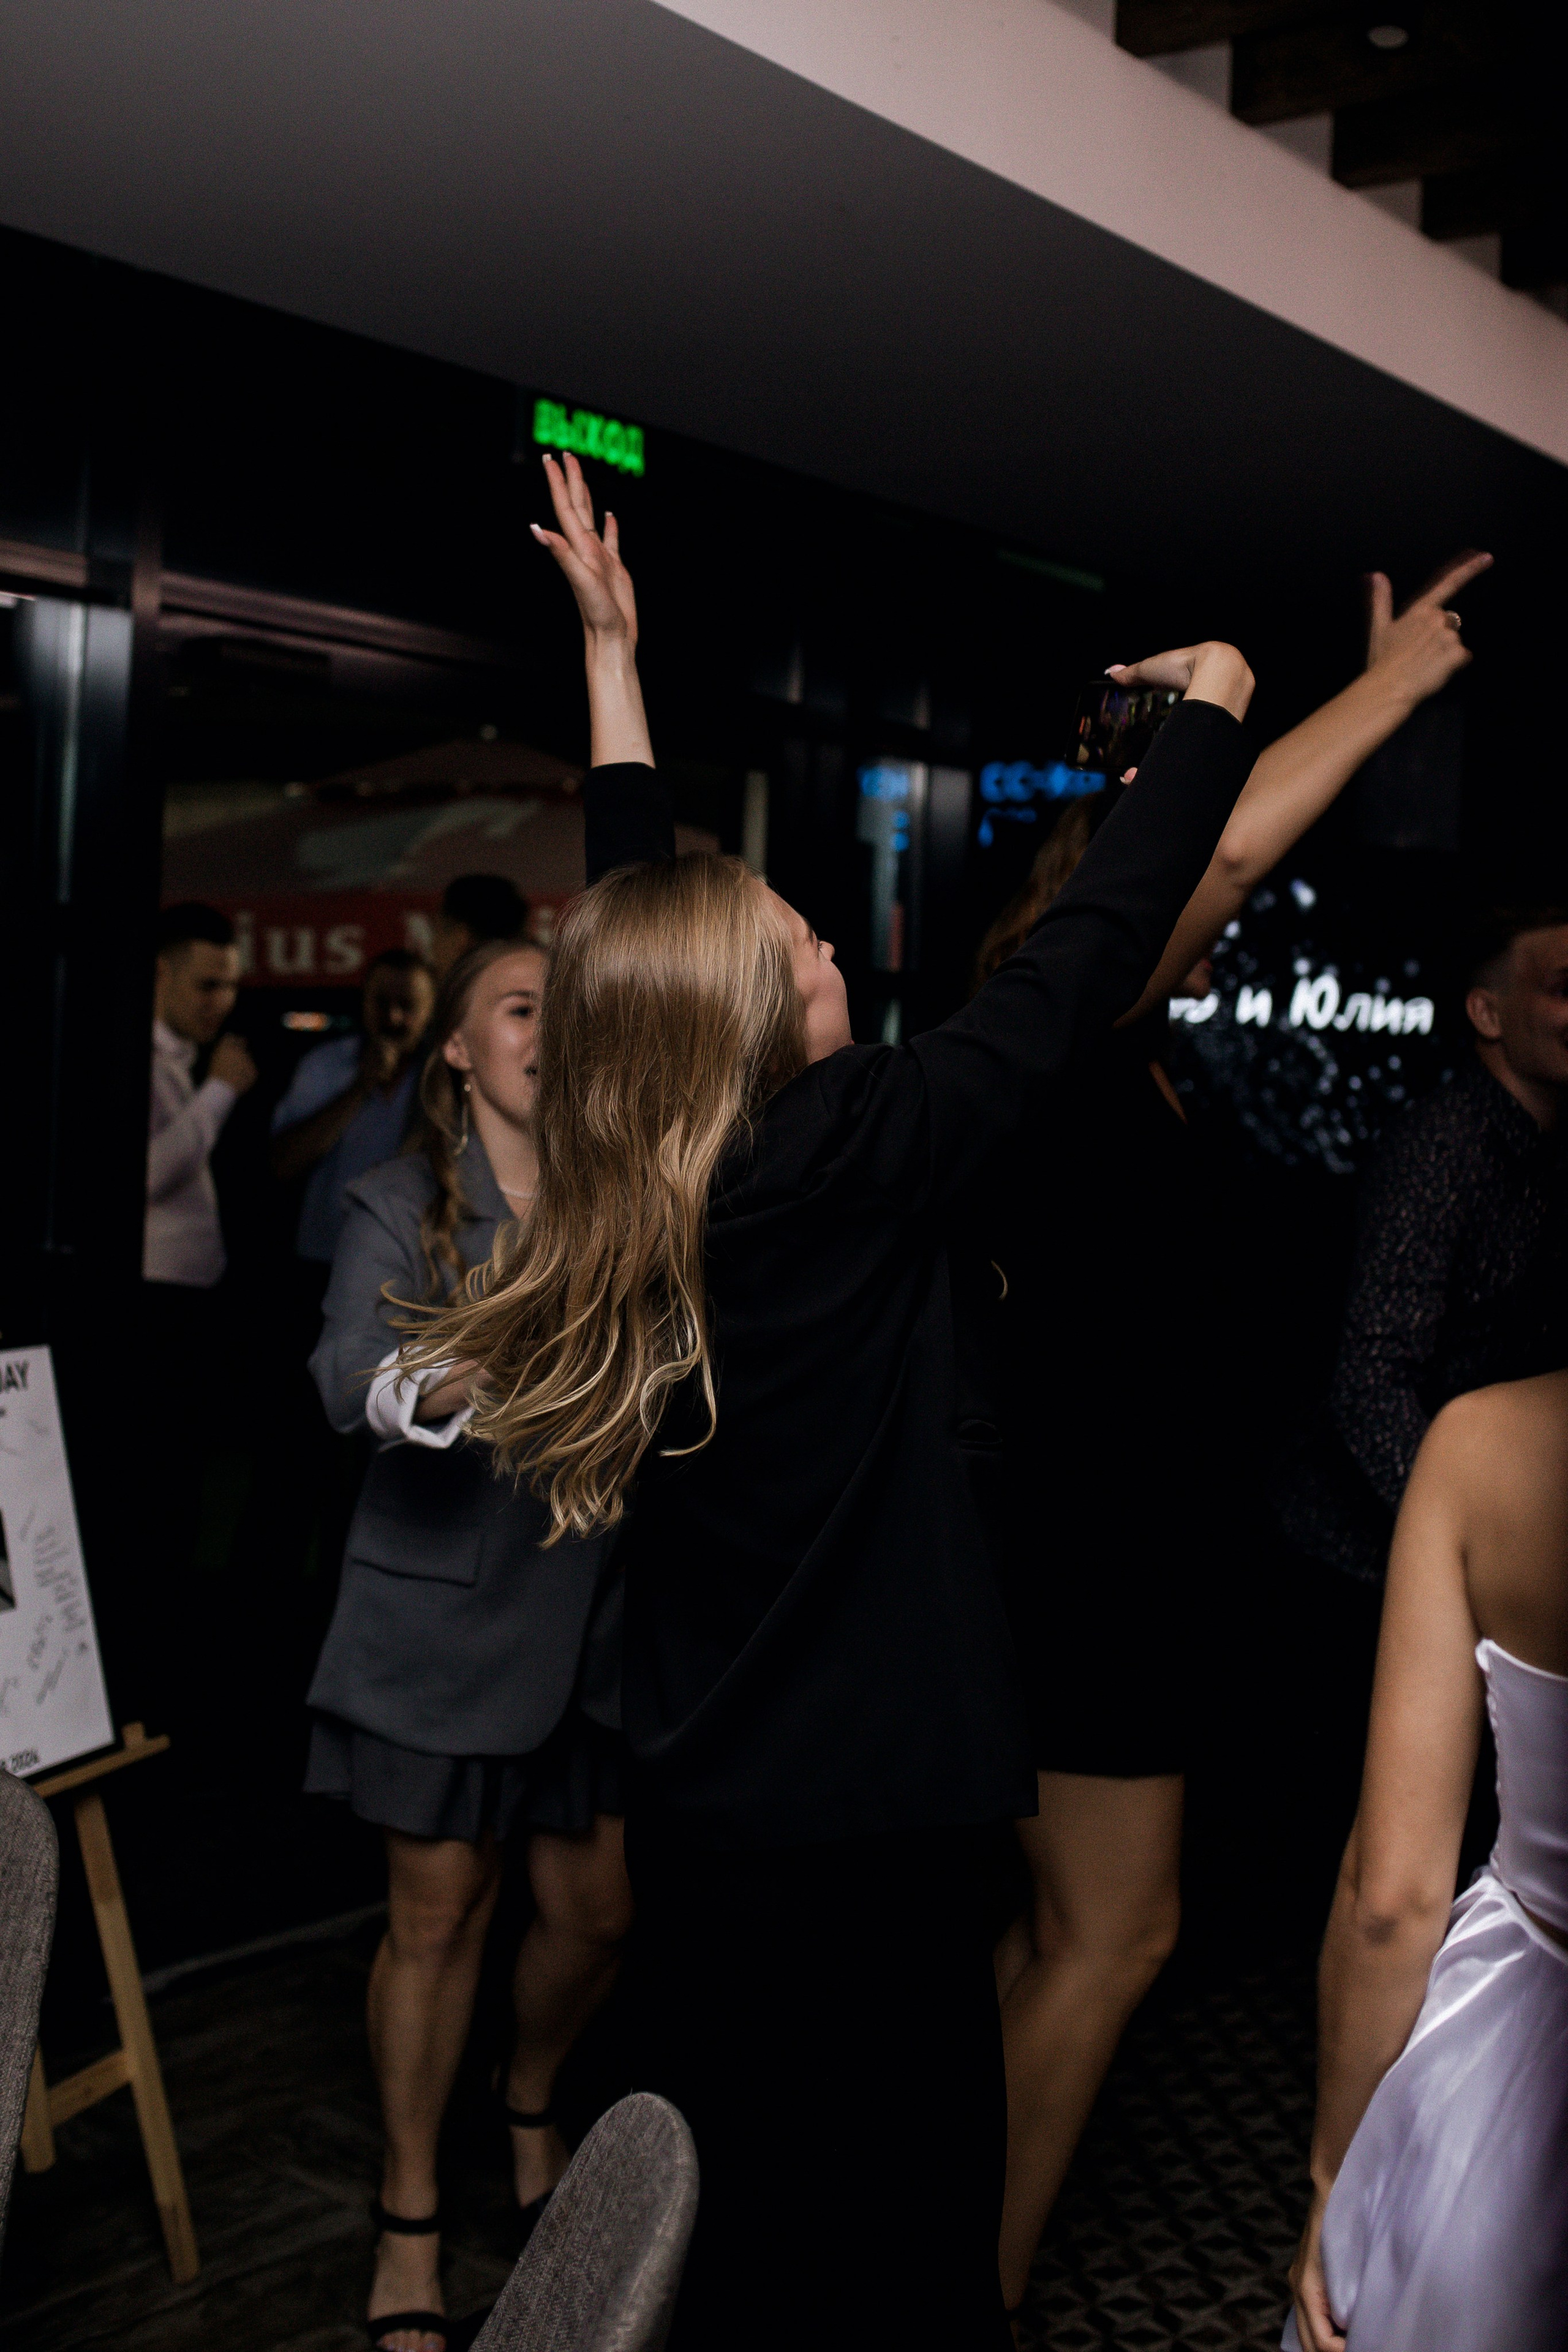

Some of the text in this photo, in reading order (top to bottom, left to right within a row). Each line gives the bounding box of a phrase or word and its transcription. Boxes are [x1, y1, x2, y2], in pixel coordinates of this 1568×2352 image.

[533, 399, 644, 477] ВЫХОД
[1288, 974, 1434, 1035] Юлия
[0, 1360, 29, 1392] AY
